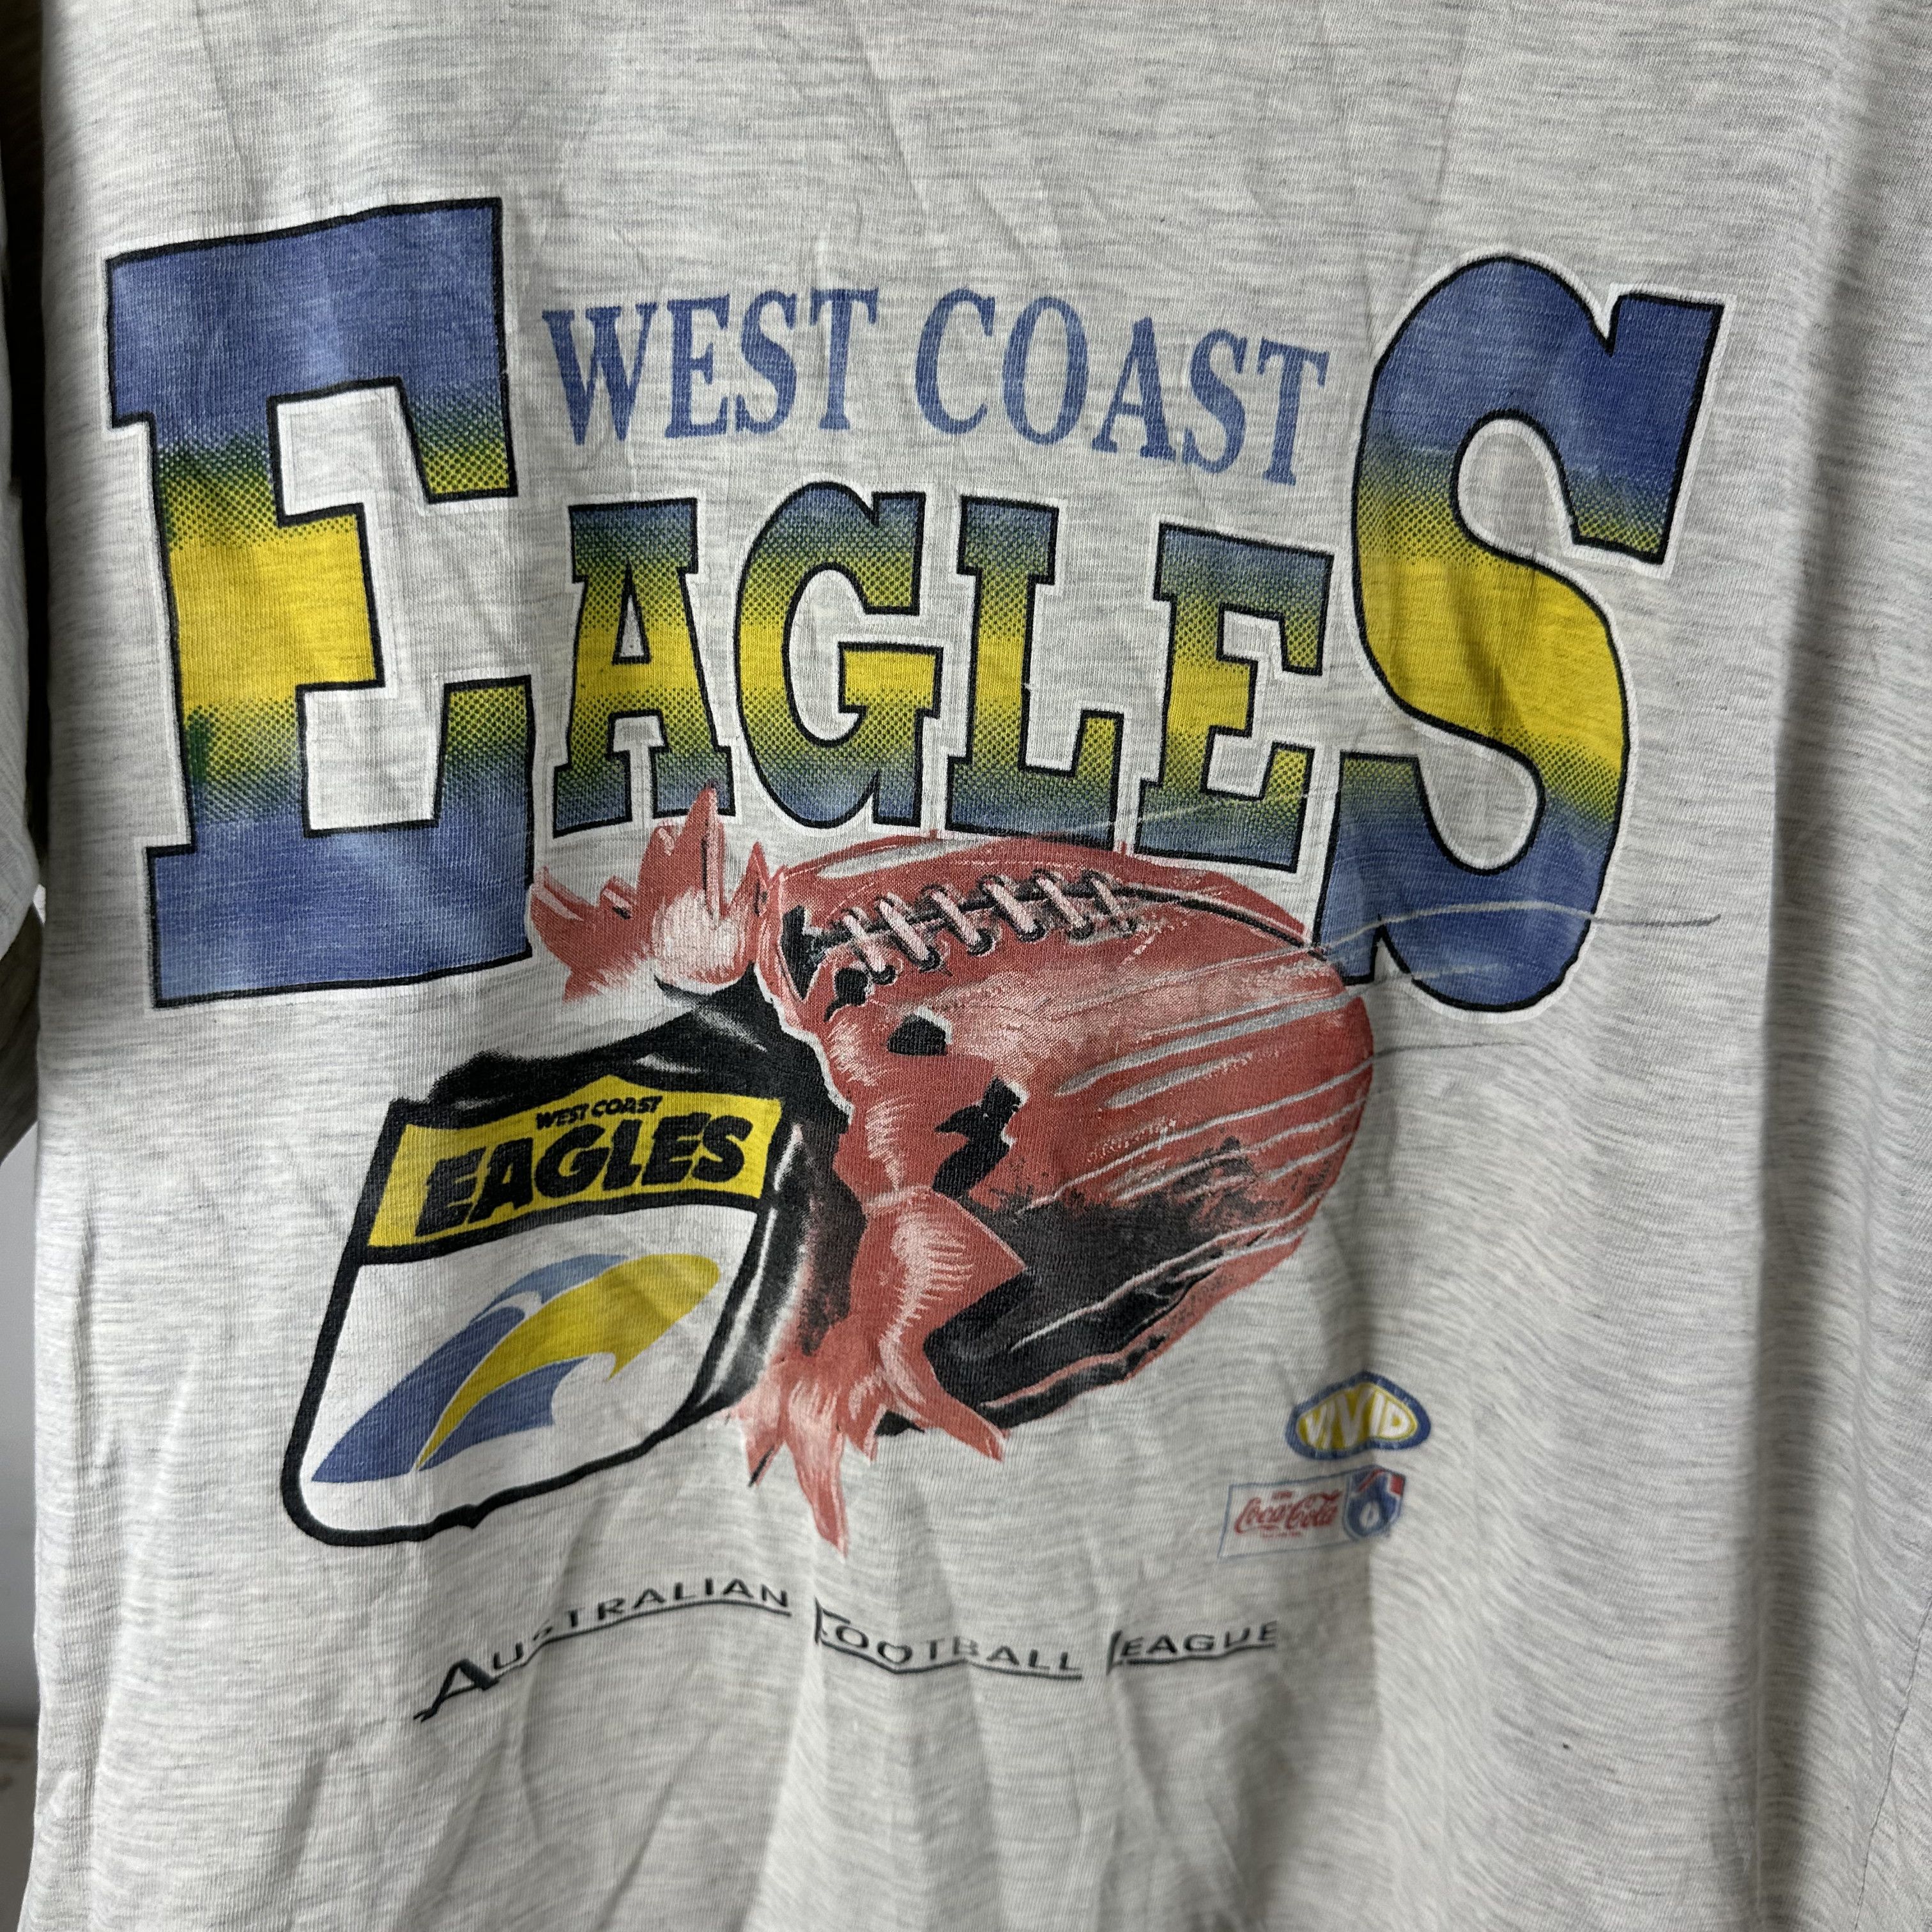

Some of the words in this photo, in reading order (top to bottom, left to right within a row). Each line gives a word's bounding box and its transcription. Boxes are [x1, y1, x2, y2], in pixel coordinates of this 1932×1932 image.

[542, 289, 879, 445] WEST
[914, 289, 1330, 487] COAST
[107, 197, 1723, 1011] EAGLES
[535, 1103, 590, 1130] WEST
[591, 1096, 663, 1117] COAST
[414, 1112, 753, 1236] EAGLES
[1305, 1386, 1413, 1450] VIVID
[814, 1596, 1082, 1678] FOOTBALL
[1107, 1619, 1278, 1675] LEAGUE
